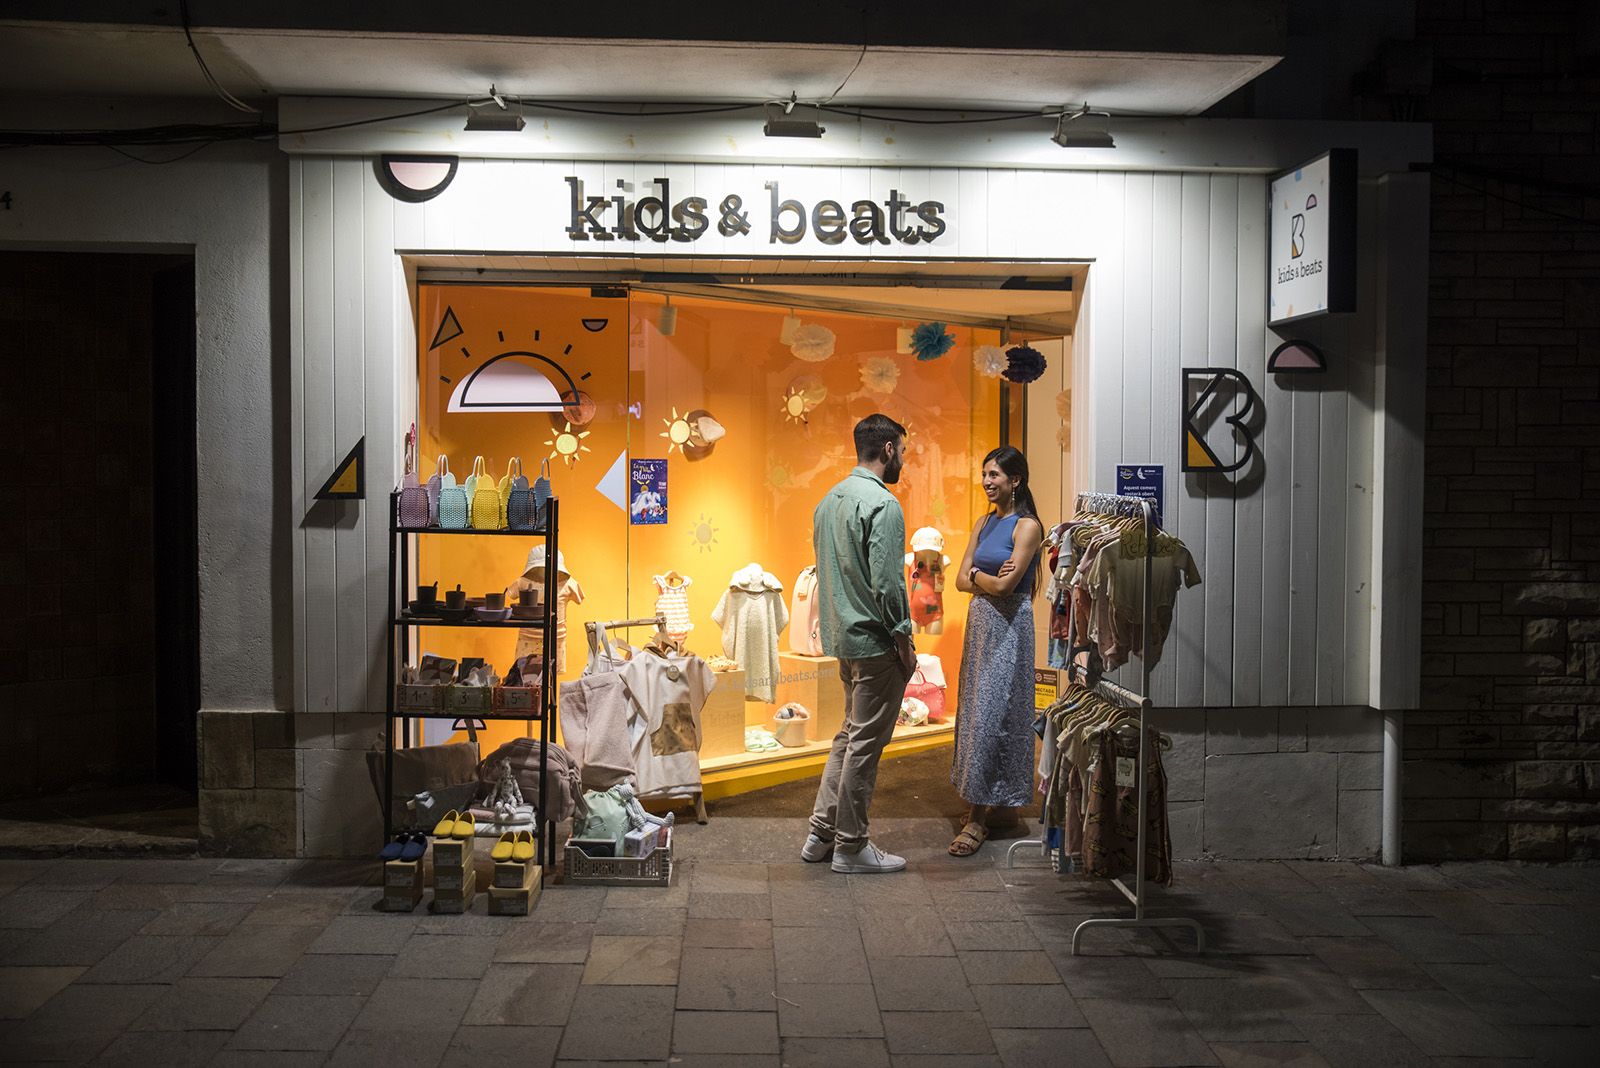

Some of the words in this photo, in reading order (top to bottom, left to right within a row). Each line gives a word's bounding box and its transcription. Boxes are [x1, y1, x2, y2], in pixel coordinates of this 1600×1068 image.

[565, 176, 709, 241] kids
[718, 193, 751, 237] &
[764, 180, 946, 243] beats
[1277, 263, 1295, 284] kids
[1300, 259, 1323, 278] beats
[632, 470, 655, 480] Blanc
[1120, 533, 1176, 557] Rebixes
